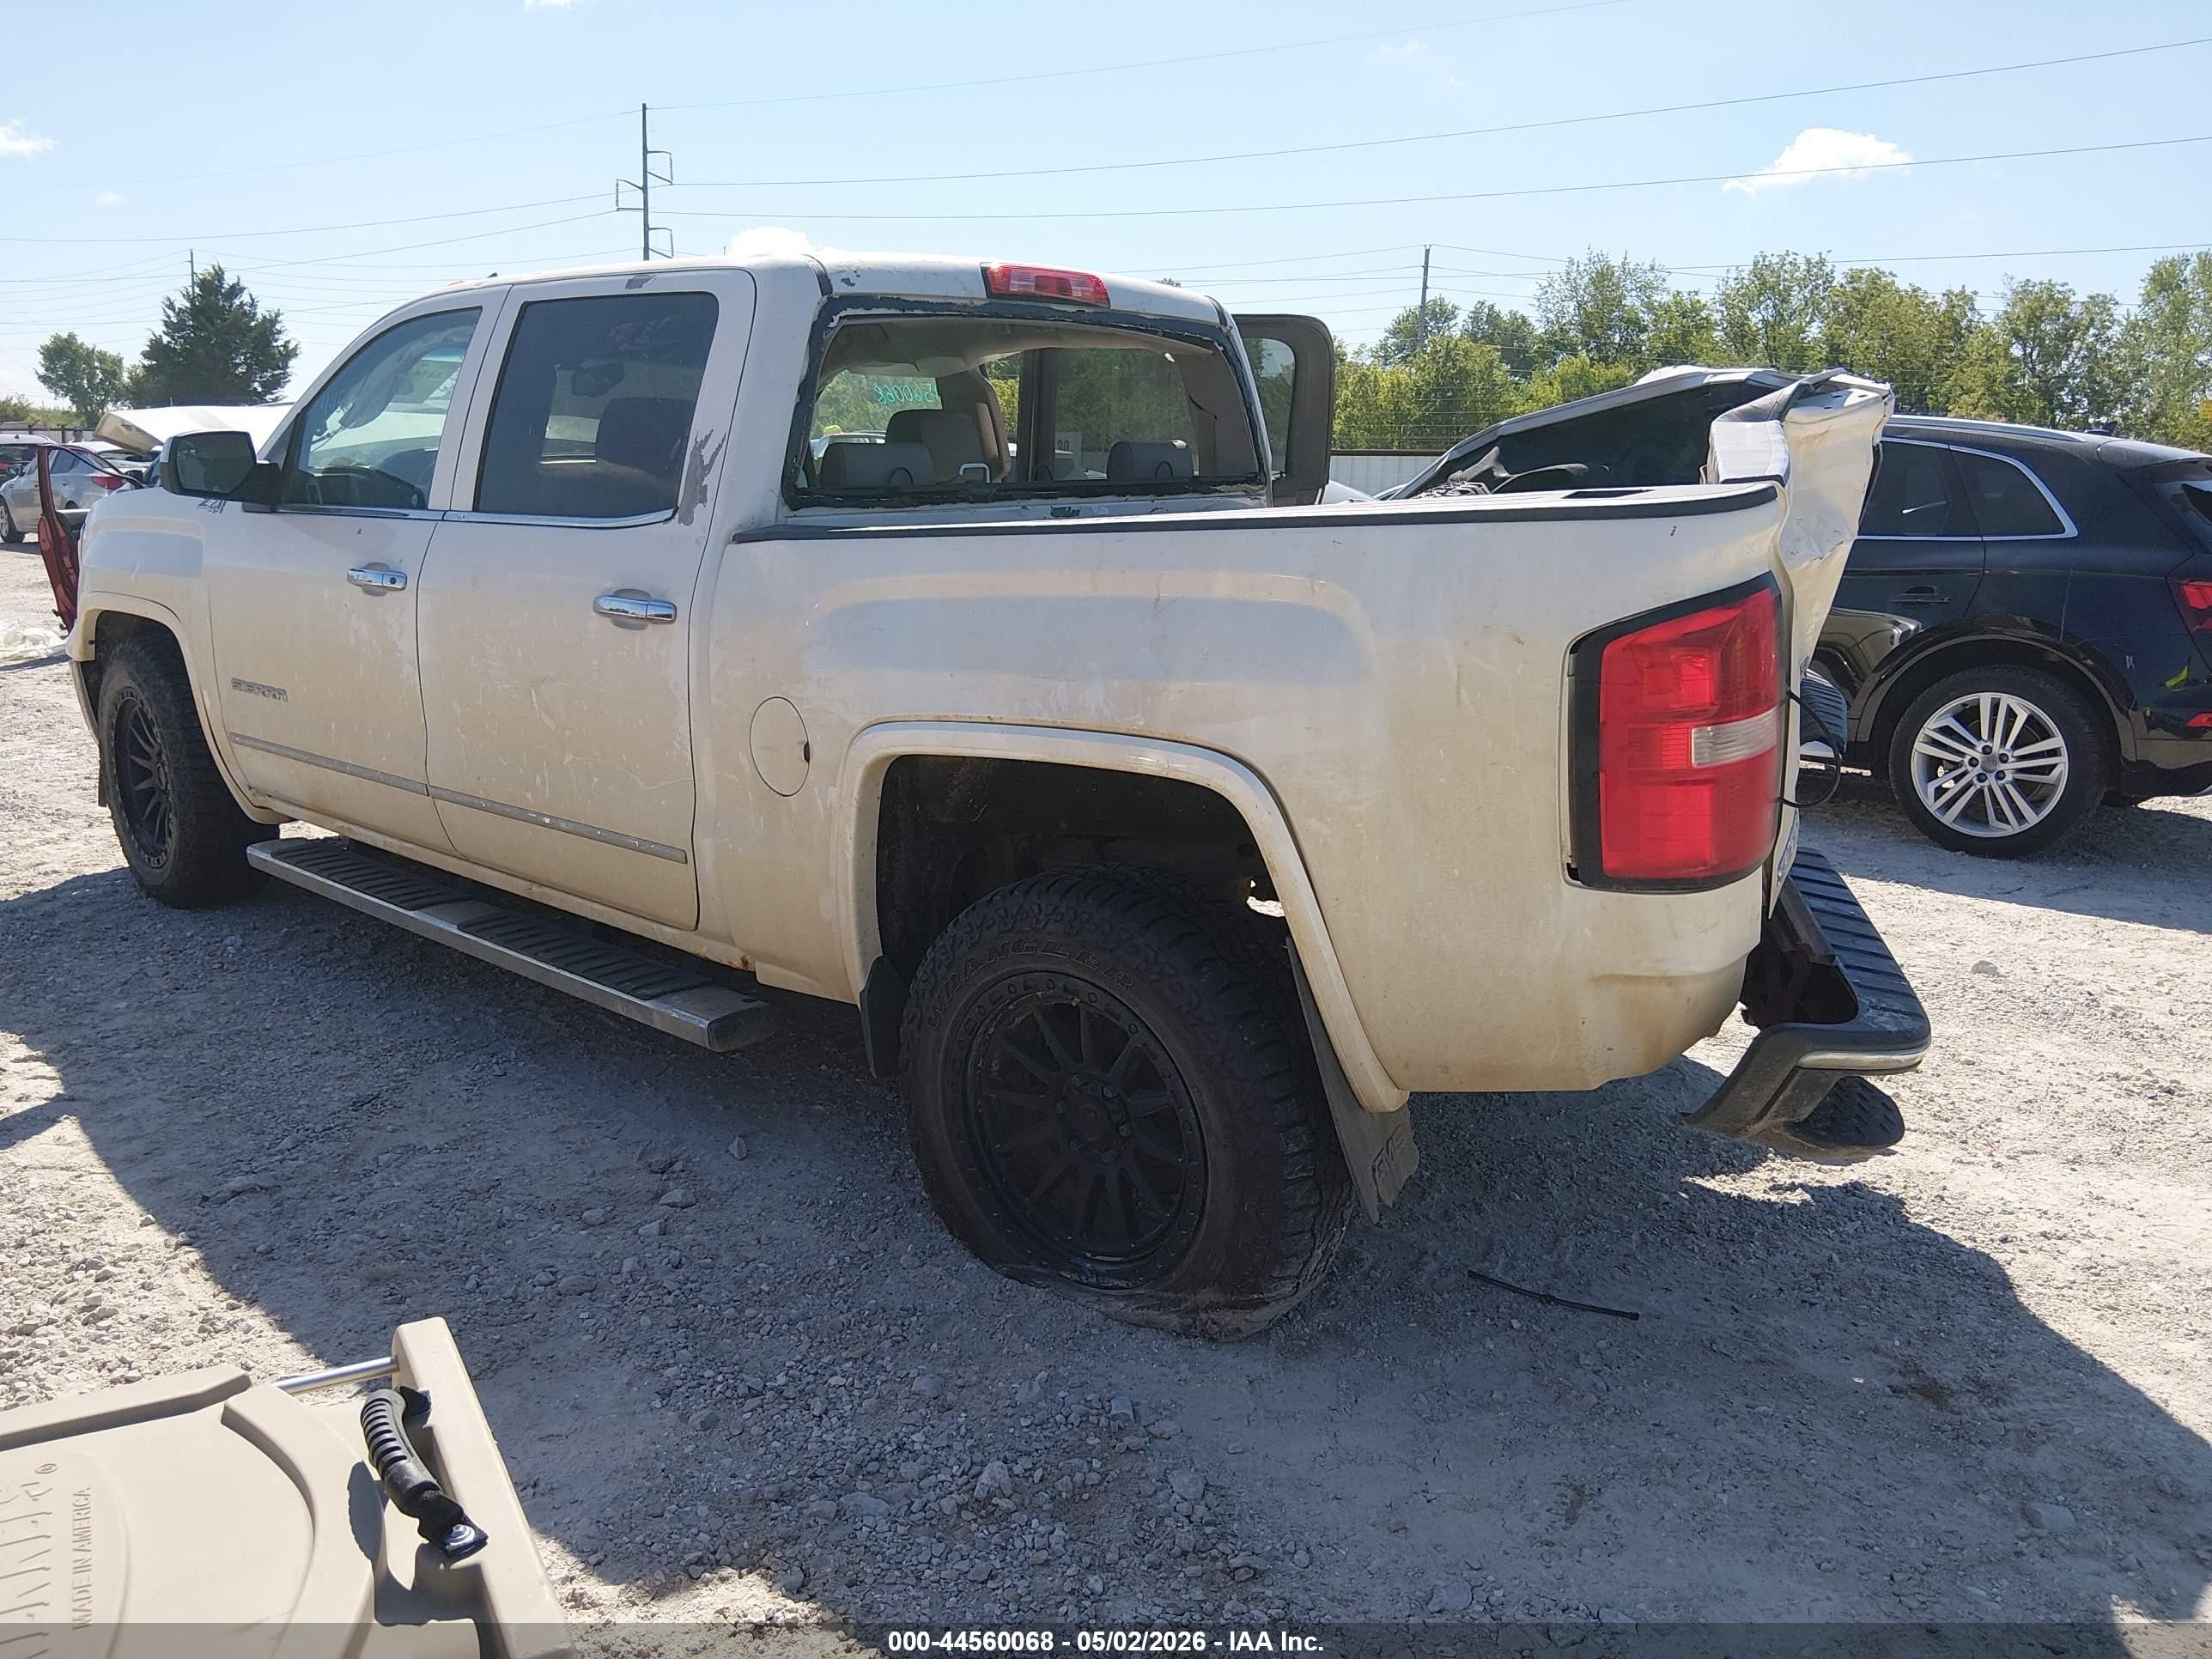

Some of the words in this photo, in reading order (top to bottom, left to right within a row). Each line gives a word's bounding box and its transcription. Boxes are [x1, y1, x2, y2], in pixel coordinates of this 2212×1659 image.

[927, 938, 1135, 1030] WRANGLER
[71, 1486, 93, 1553] AMERICA
[71, 1558, 93, 1575] IN
[71, 1577, 94, 1631] MADE
